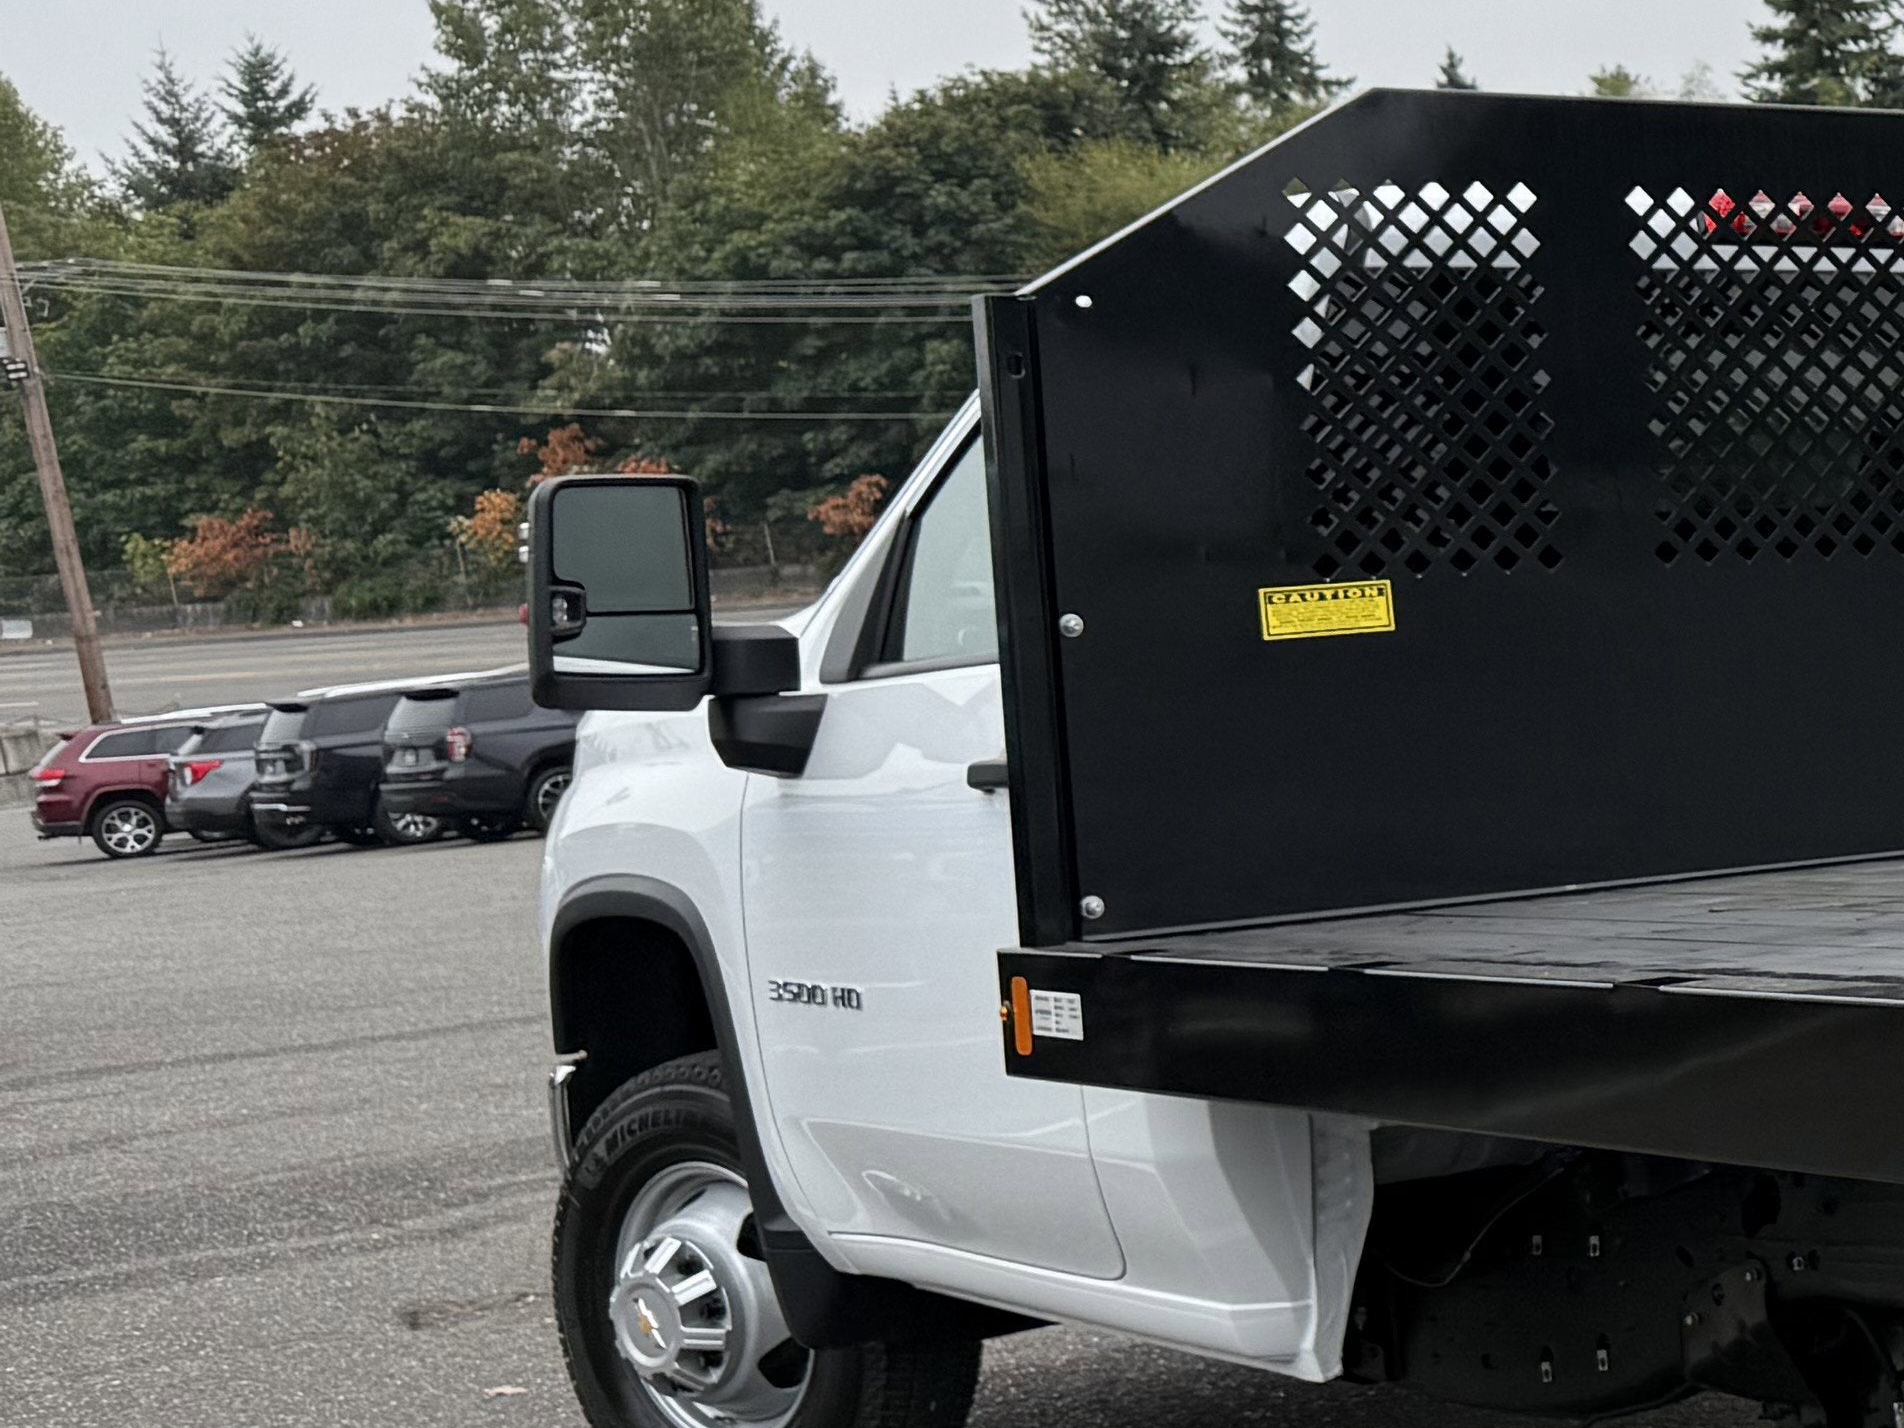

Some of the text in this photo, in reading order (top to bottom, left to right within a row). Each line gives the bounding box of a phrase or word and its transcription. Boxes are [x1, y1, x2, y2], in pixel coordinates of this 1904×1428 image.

[1272, 587, 1379, 604] CAUTION
[768, 979, 863, 1011] 3500 HD
